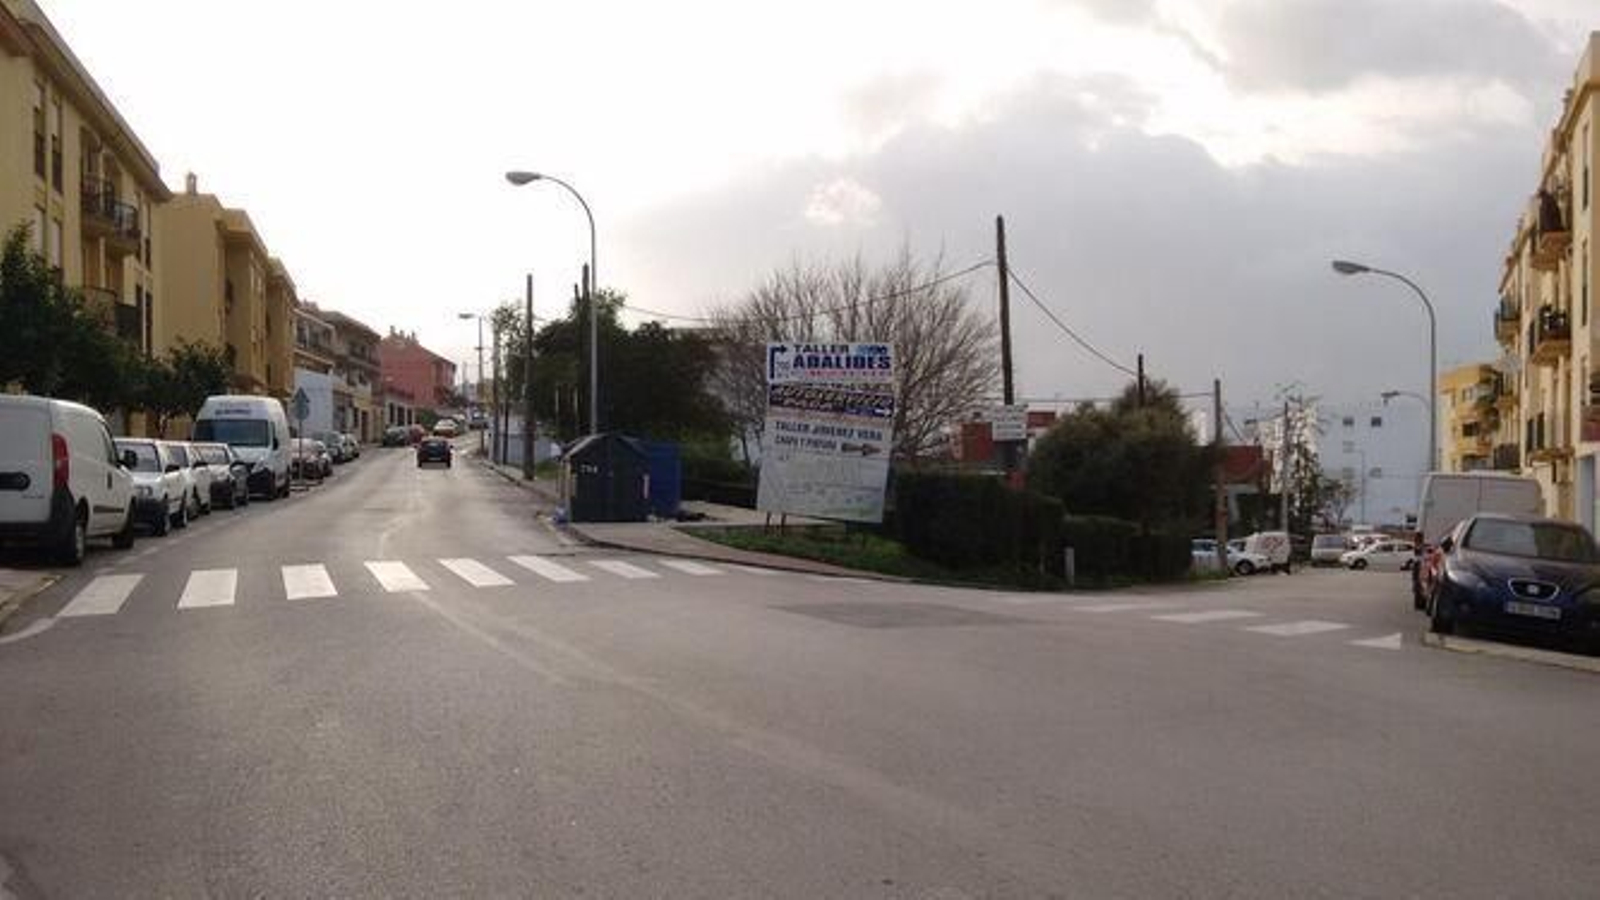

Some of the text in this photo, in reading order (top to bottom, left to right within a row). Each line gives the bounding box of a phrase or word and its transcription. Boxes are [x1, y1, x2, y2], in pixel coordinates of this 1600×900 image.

[794, 344, 849, 353] TALLER
[793, 355, 891, 369] ADALIDES
[775, 421, 809, 432] TALLER
